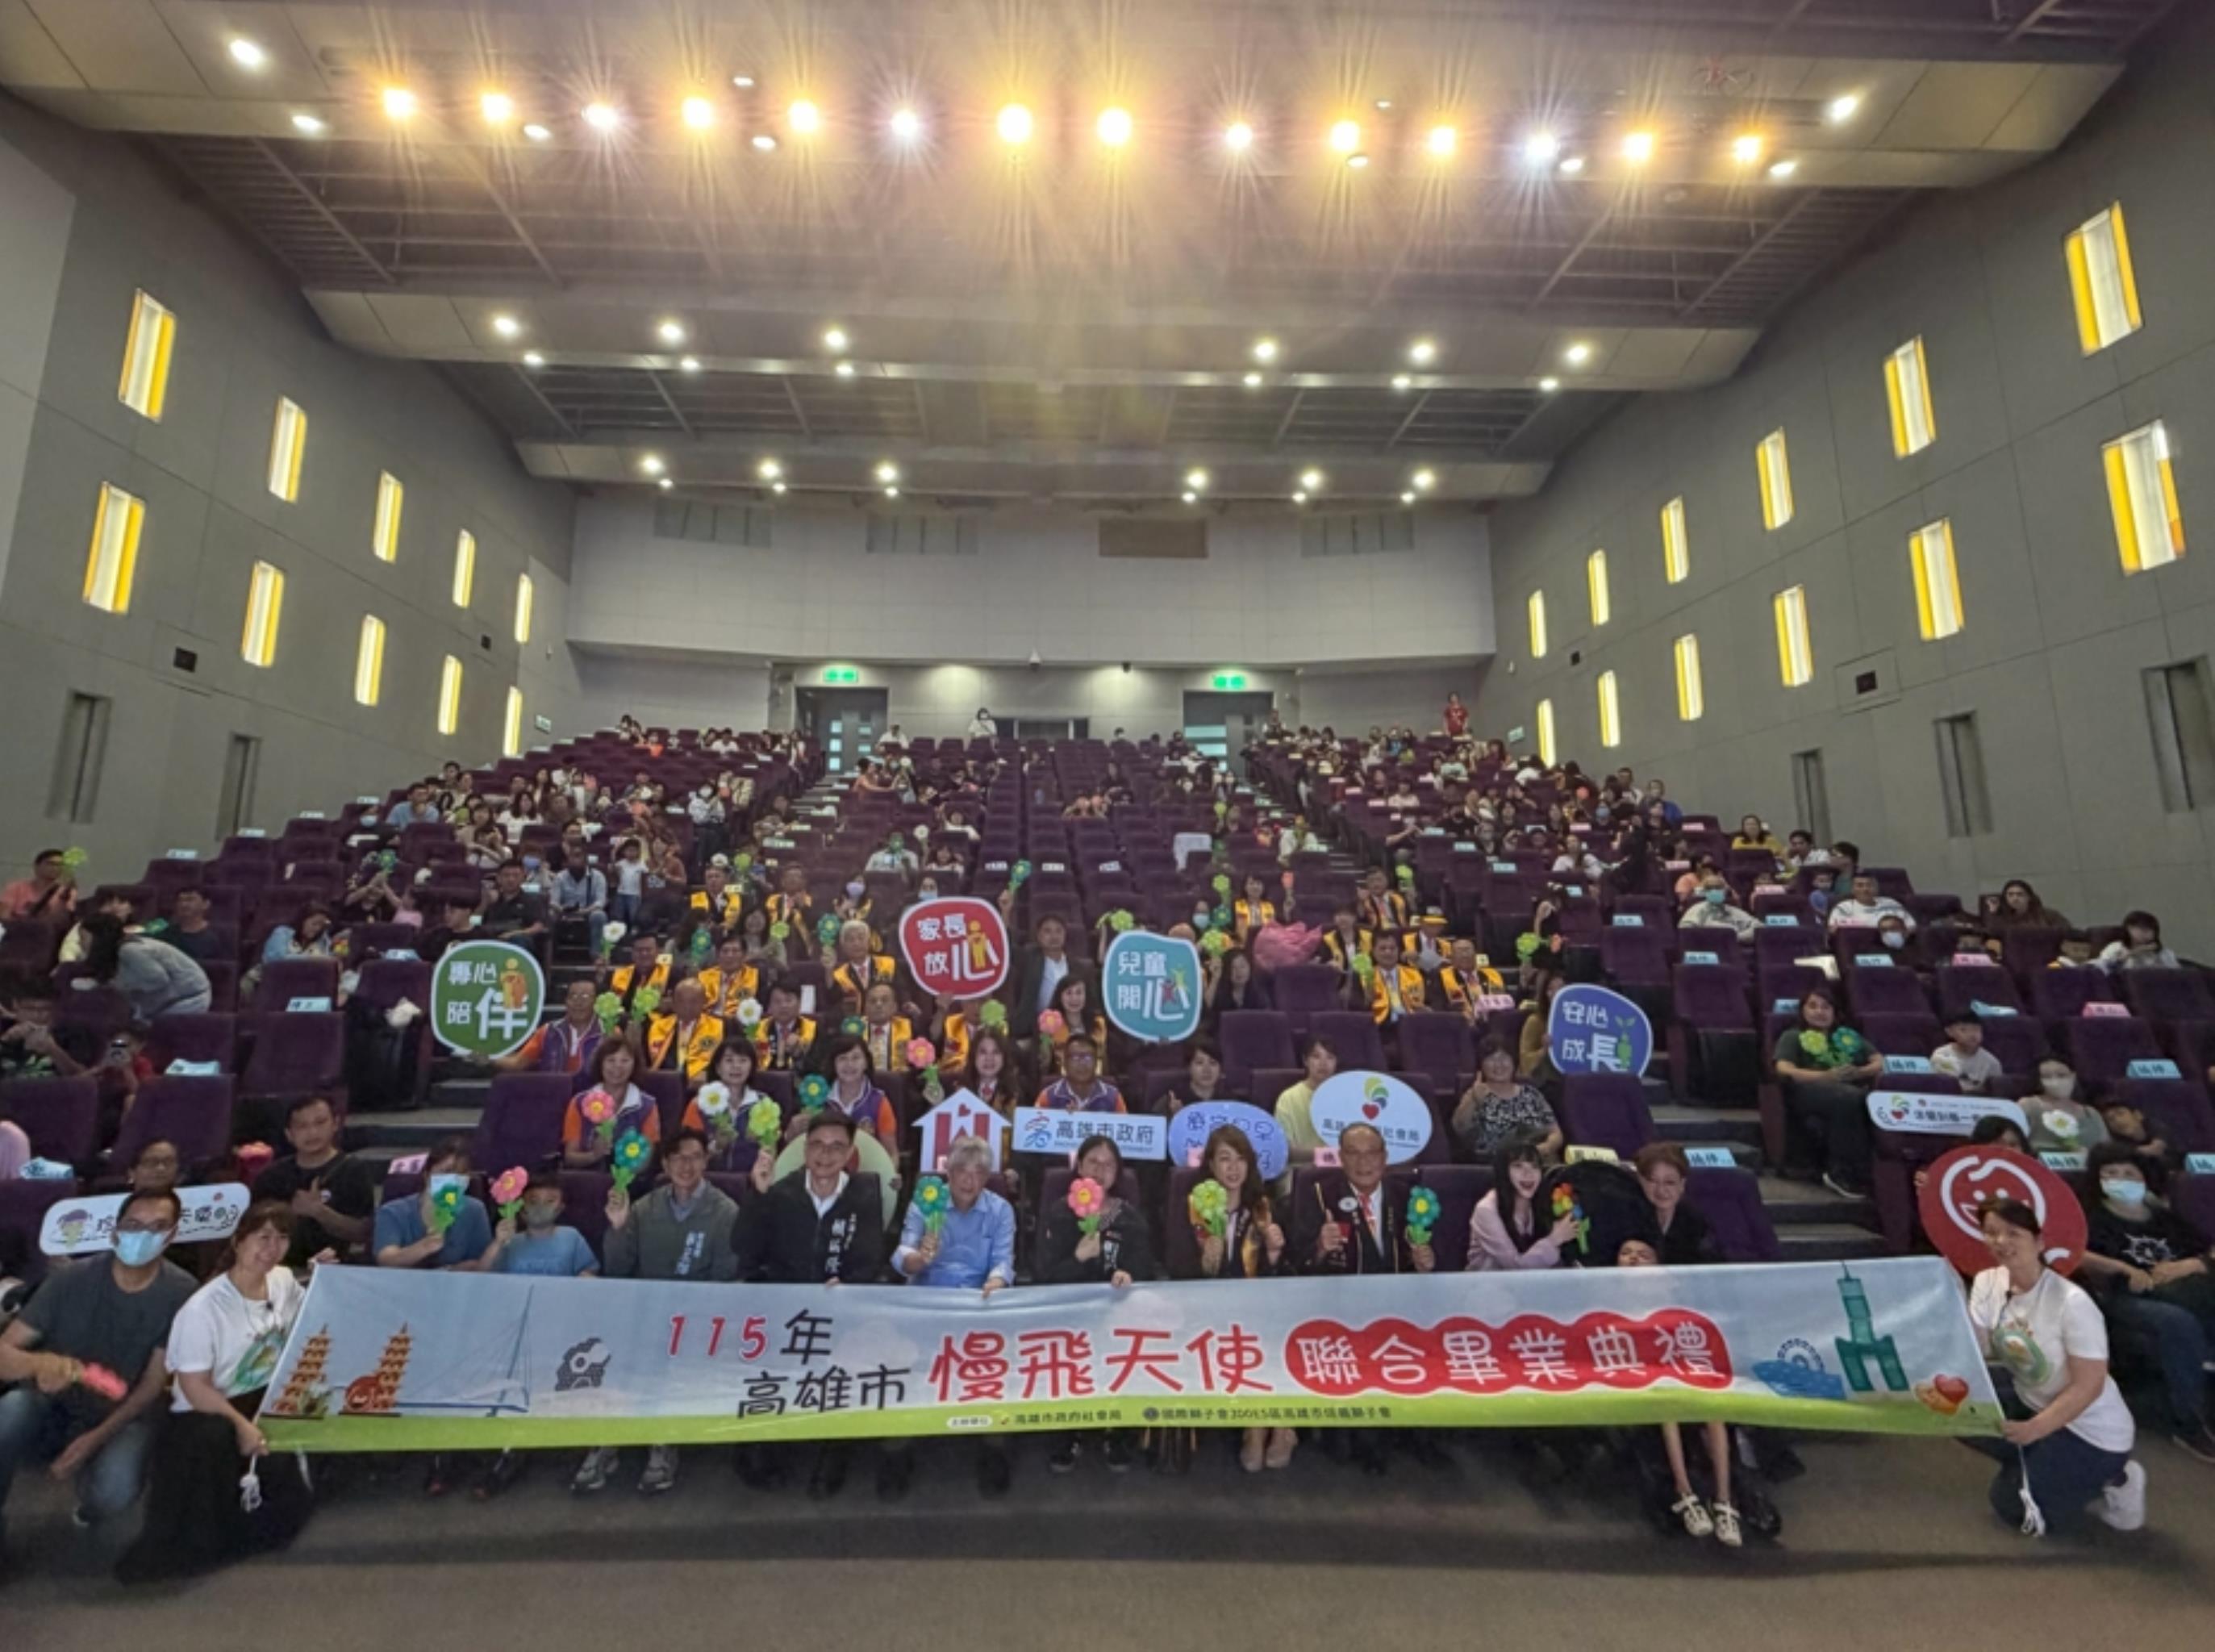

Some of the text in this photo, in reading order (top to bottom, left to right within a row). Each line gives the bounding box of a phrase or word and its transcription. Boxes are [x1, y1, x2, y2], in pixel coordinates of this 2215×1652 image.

[917, 913, 966, 941] 家長
[1118, 951, 1167, 977] 兒童
[1118, 978, 1191, 1020] 開心
[928, 1318, 1726, 1404] 慢飛天使 聯合畢業典禮
[737, 1365, 911, 1419] 高雄市
